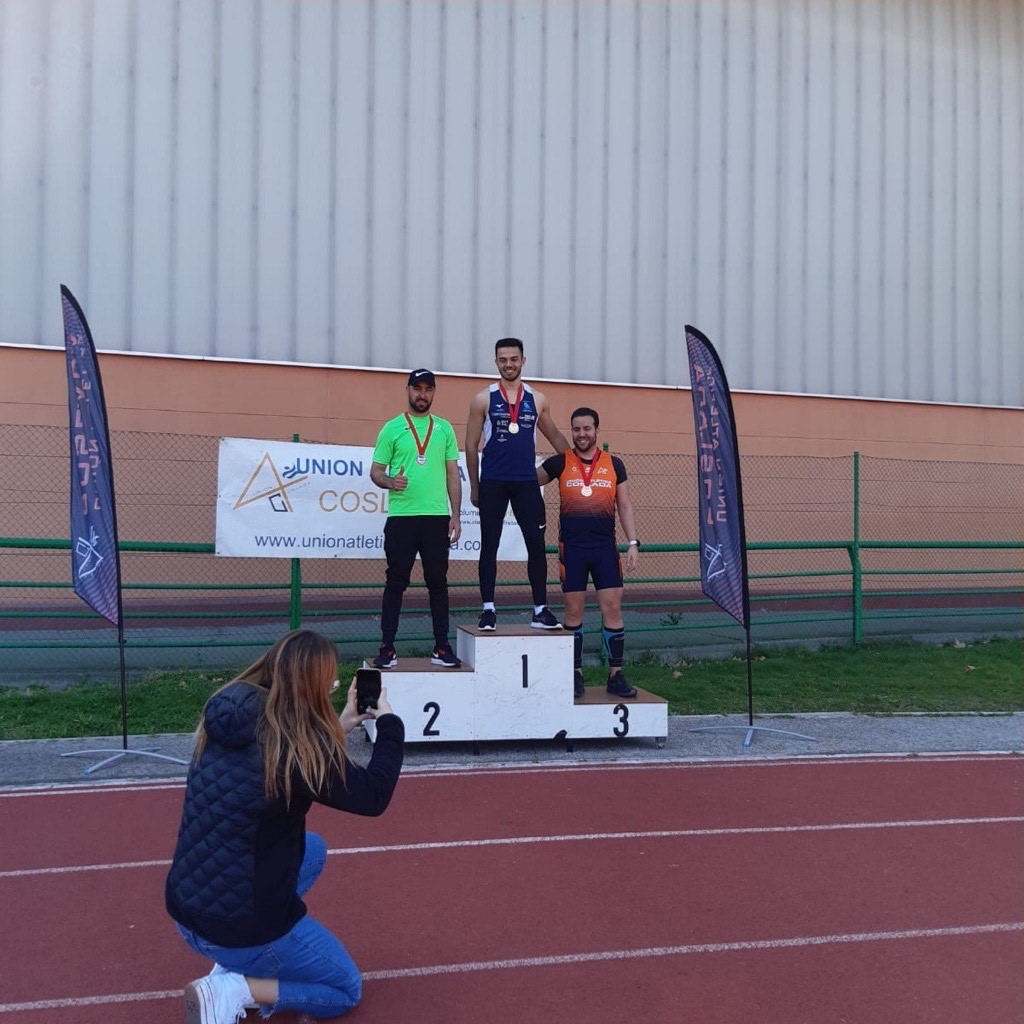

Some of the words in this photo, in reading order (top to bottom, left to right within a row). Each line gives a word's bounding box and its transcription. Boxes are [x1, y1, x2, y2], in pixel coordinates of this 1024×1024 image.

[296, 457, 363, 477] UNION
[318, 489, 389, 514] COSL
[521, 654, 529, 689] 1
[422, 701, 441, 736] 2
[612, 703, 630, 737] 3
